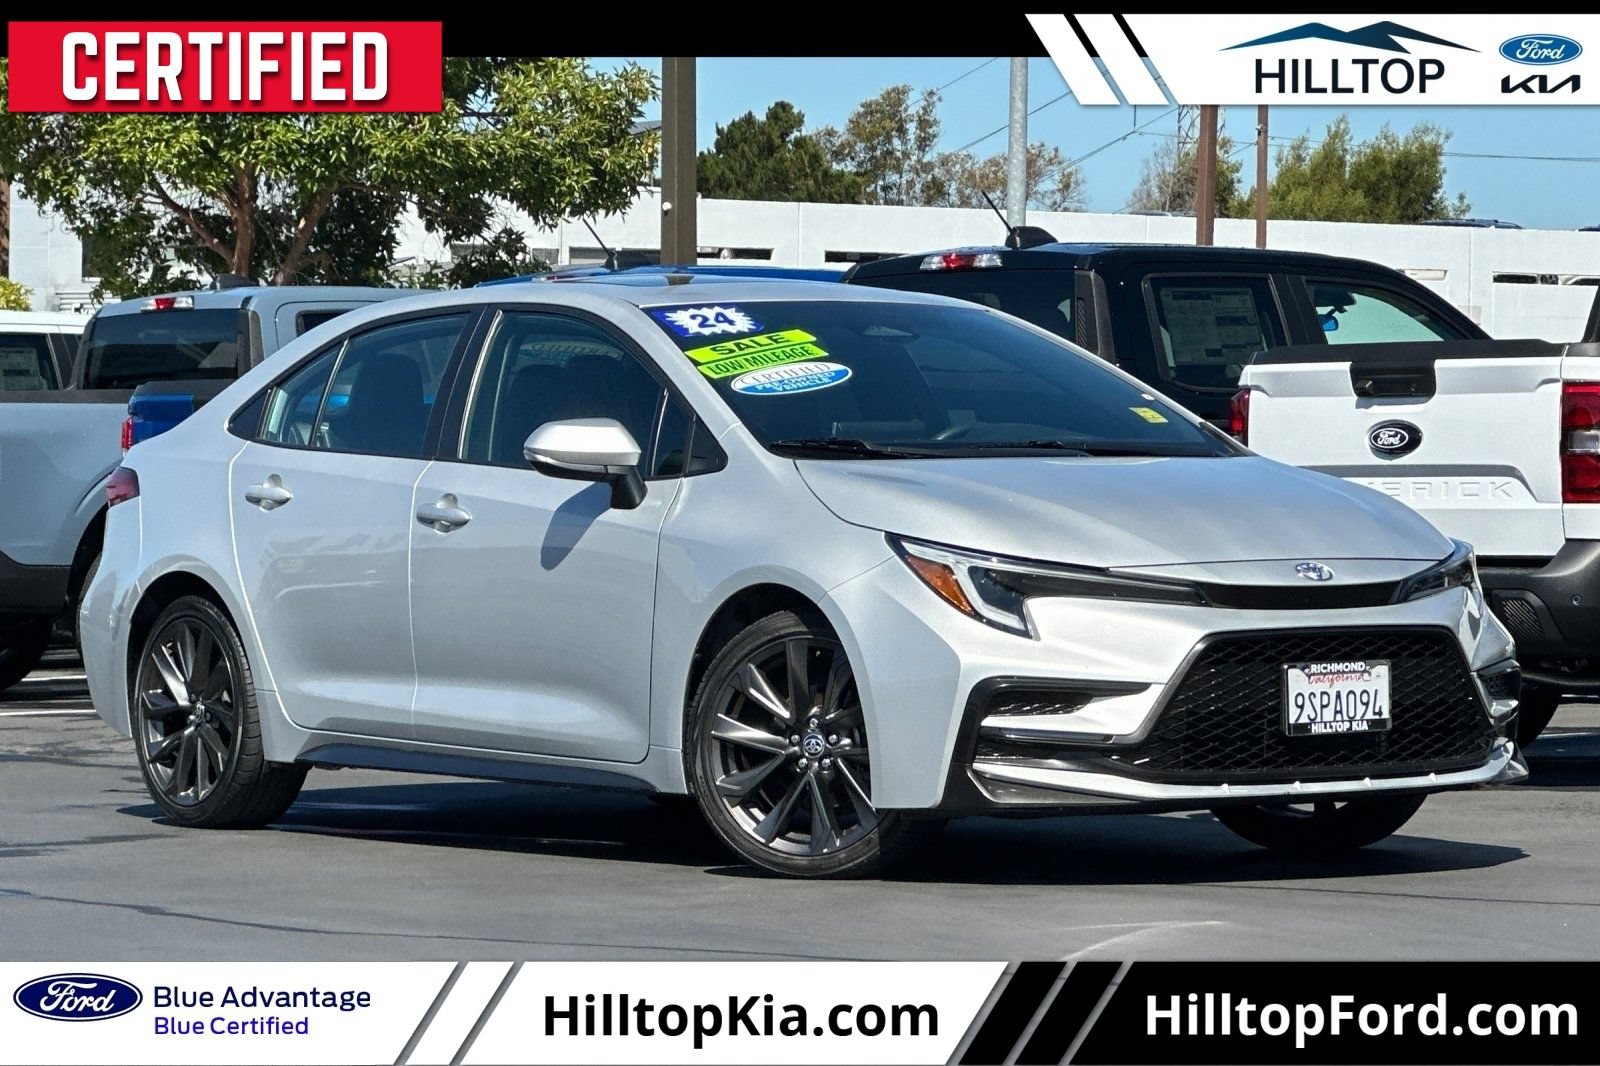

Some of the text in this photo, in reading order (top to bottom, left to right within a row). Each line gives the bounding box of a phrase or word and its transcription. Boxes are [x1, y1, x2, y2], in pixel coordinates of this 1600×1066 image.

[689, 311, 737, 328] 24
[710, 333, 792, 356] SALE
[707, 345, 813, 375] LOW MILEAGE
[1377, 430, 1401, 446] Ford
[1367, 481, 1512, 500] ERICK
[1310, 662, 1366, 674] RICHMOND
[1307, 673, 1371, 688] California
[1294, 689, 1383, 723] 9SPA094
[1311, 720, 1369, 734] HILLTOP KIA
